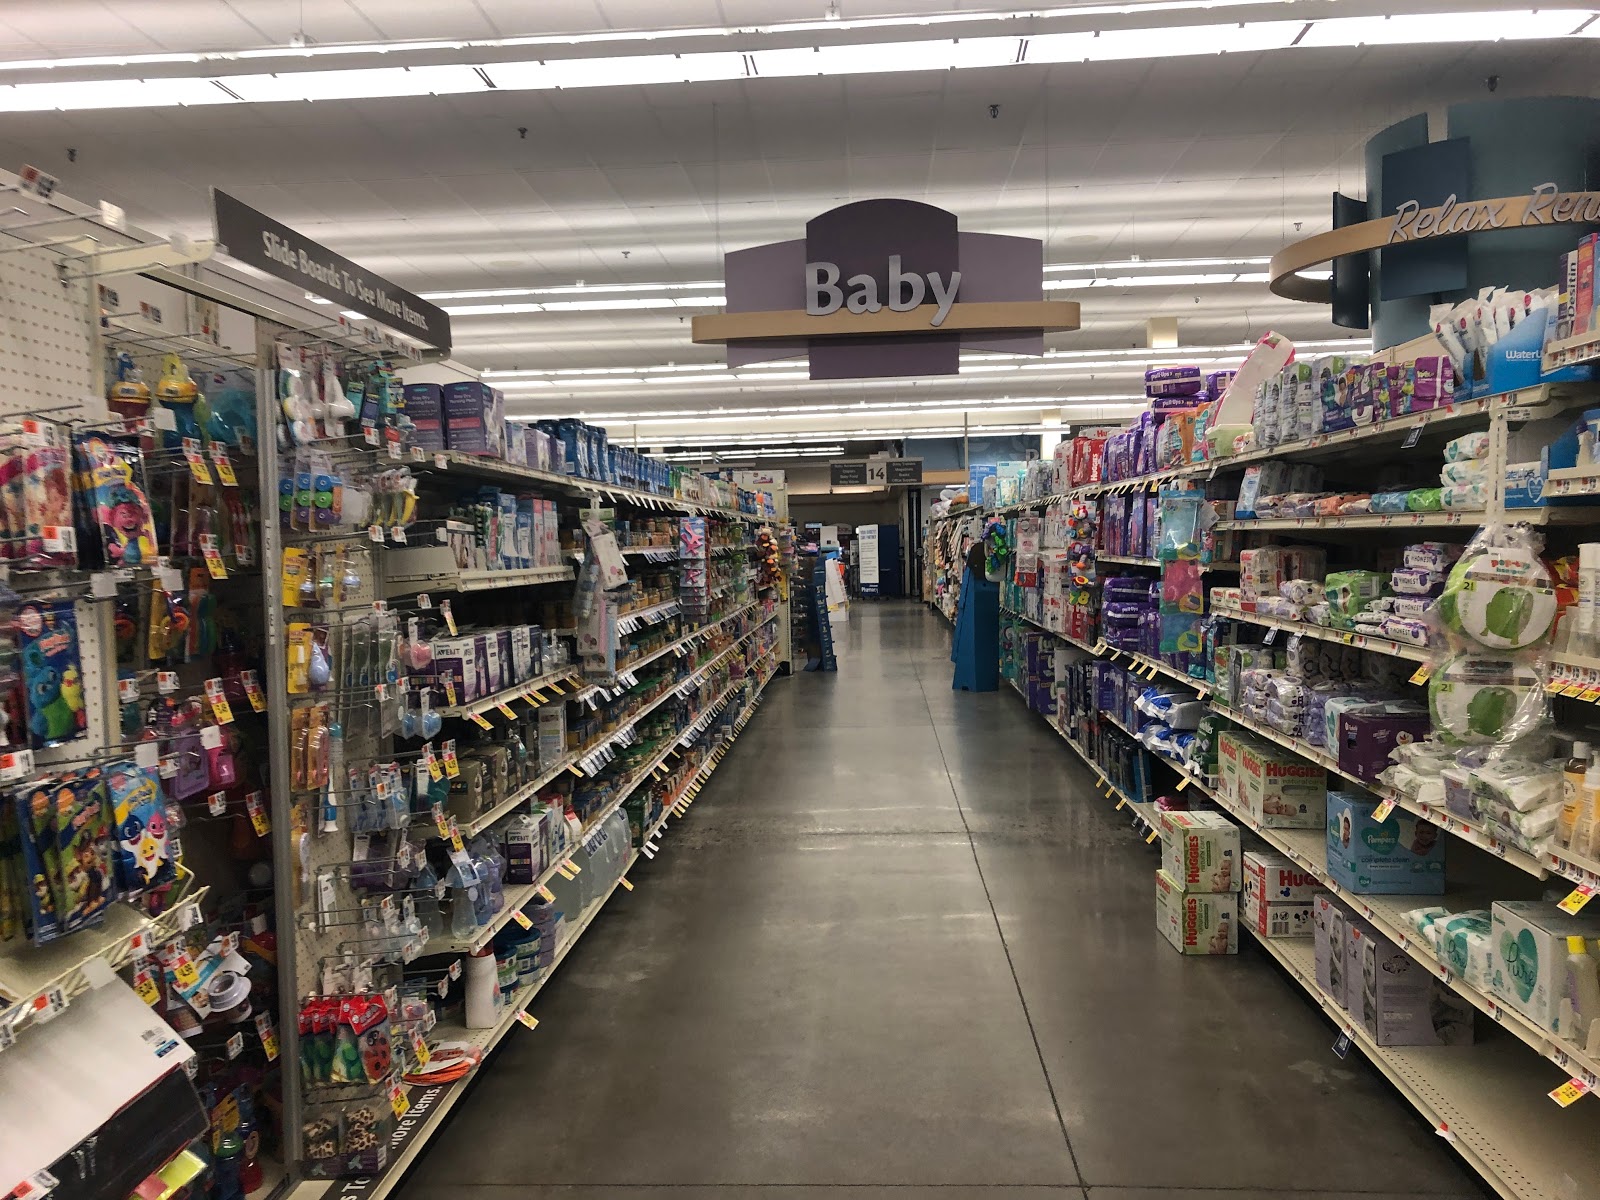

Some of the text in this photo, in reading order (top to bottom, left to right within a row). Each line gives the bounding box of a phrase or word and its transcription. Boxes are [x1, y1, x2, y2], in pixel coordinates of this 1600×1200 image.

[1388, 182, 1600, 243] Relax Ren
[262, 230, 298, 270] Slide
[298, 249, 342, 290] Boards
[341, 270, 358, 297] To
[357, 277, 376, 306] See
[376, 288, 401, 317] More
[806, 255, 962, 327] Baby
[1568, 262, 1577, 318] Desitin
[868, 468, 885, 480] 14
[437, 648, 460, 657] AVENT
[1266, 763, 1325, 777] HUGGIES
[1188, 835, 1199, 884] HUGGIES
[1368, 834, 1396, 844] Pampers
[1186, 898, 1197, 946] HUGGIES
[392, 1117, 416, 1150] ore
[408, 1085, 443, 1118] Items.
